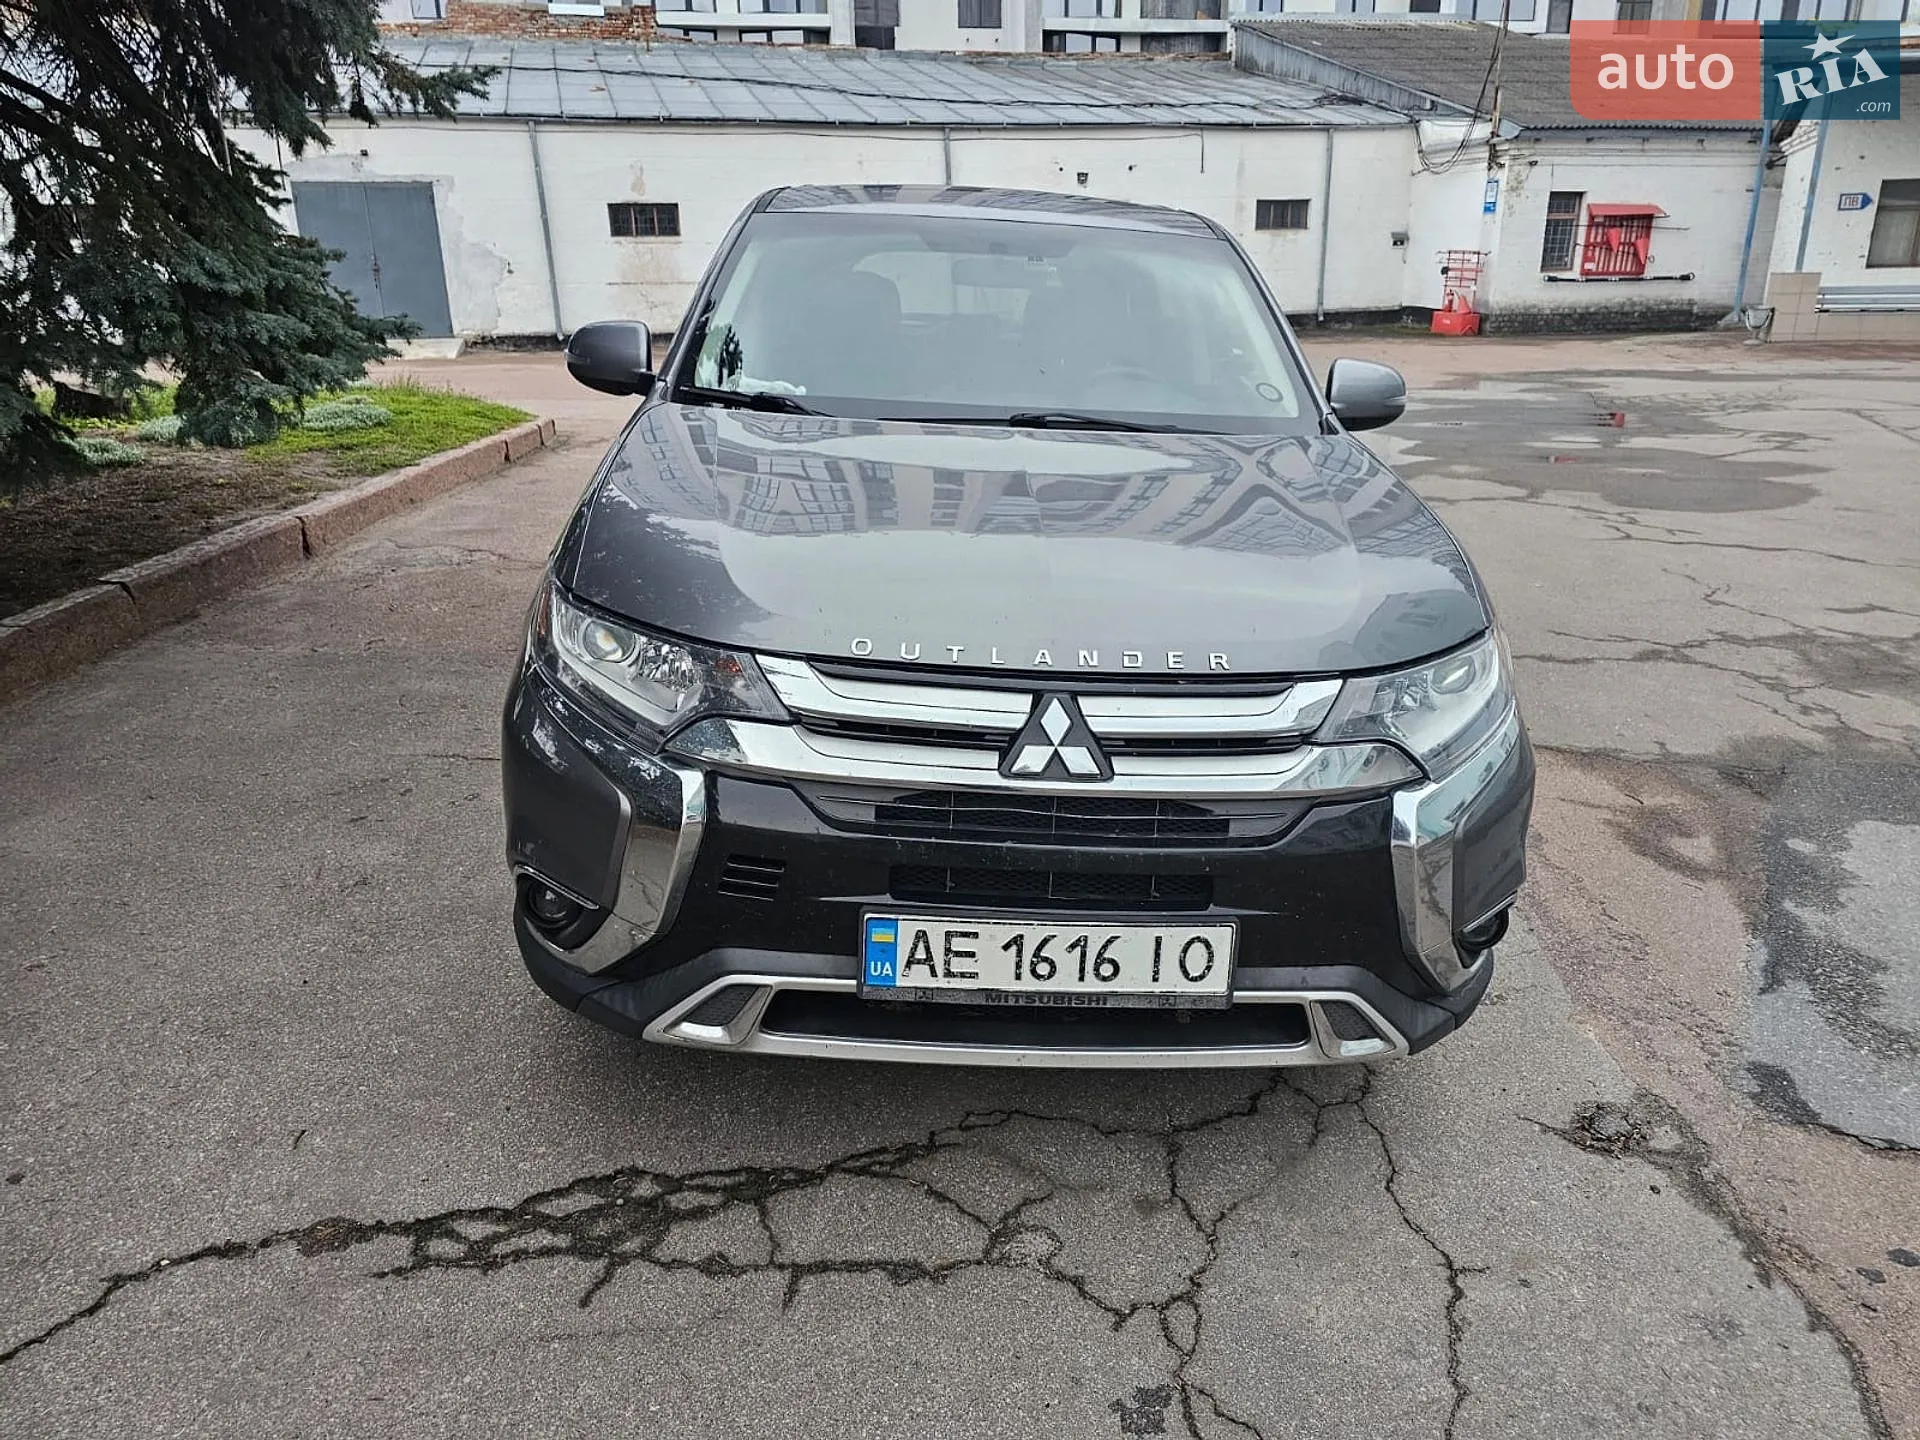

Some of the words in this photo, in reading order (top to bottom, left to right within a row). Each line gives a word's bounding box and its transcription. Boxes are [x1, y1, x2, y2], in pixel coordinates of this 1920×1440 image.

[850, 638, 1231, 670] OUTLANDER
[901, 929, 980, 979] AE
[1001, 933, 1122, 983] 1616
[1152, 935, 1215, 983] IO
[870, 961, 893, 977] UA
[984, 992, 1109, 1007] MITSUBISHI
